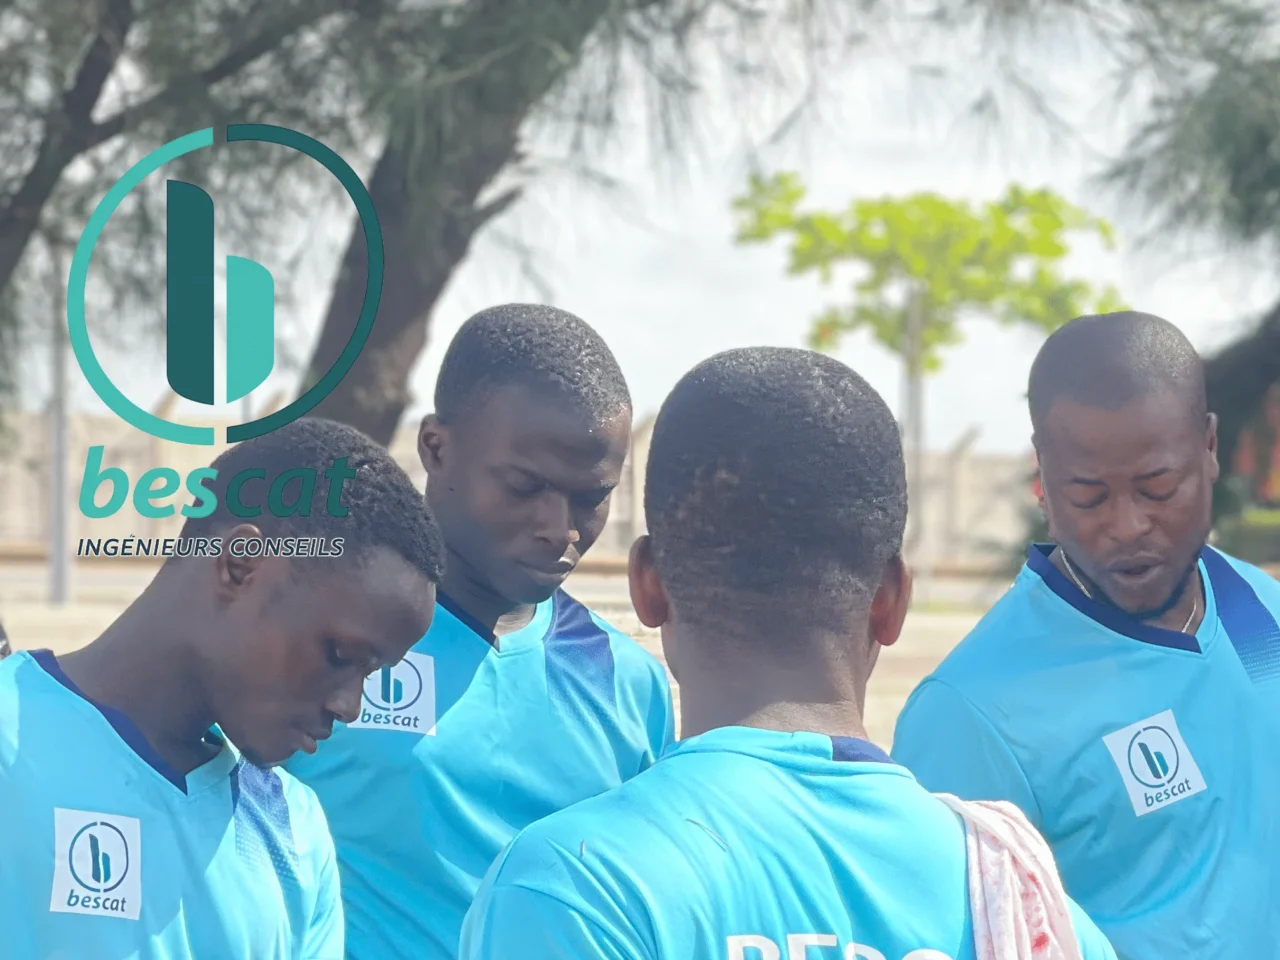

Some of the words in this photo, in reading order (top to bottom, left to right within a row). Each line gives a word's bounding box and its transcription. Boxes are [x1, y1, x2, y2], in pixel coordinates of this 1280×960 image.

[361, 708, 420, 728] bescat
[1143, 778, 1192, 807] bescat
[66, 889, 127, 912] bescat
